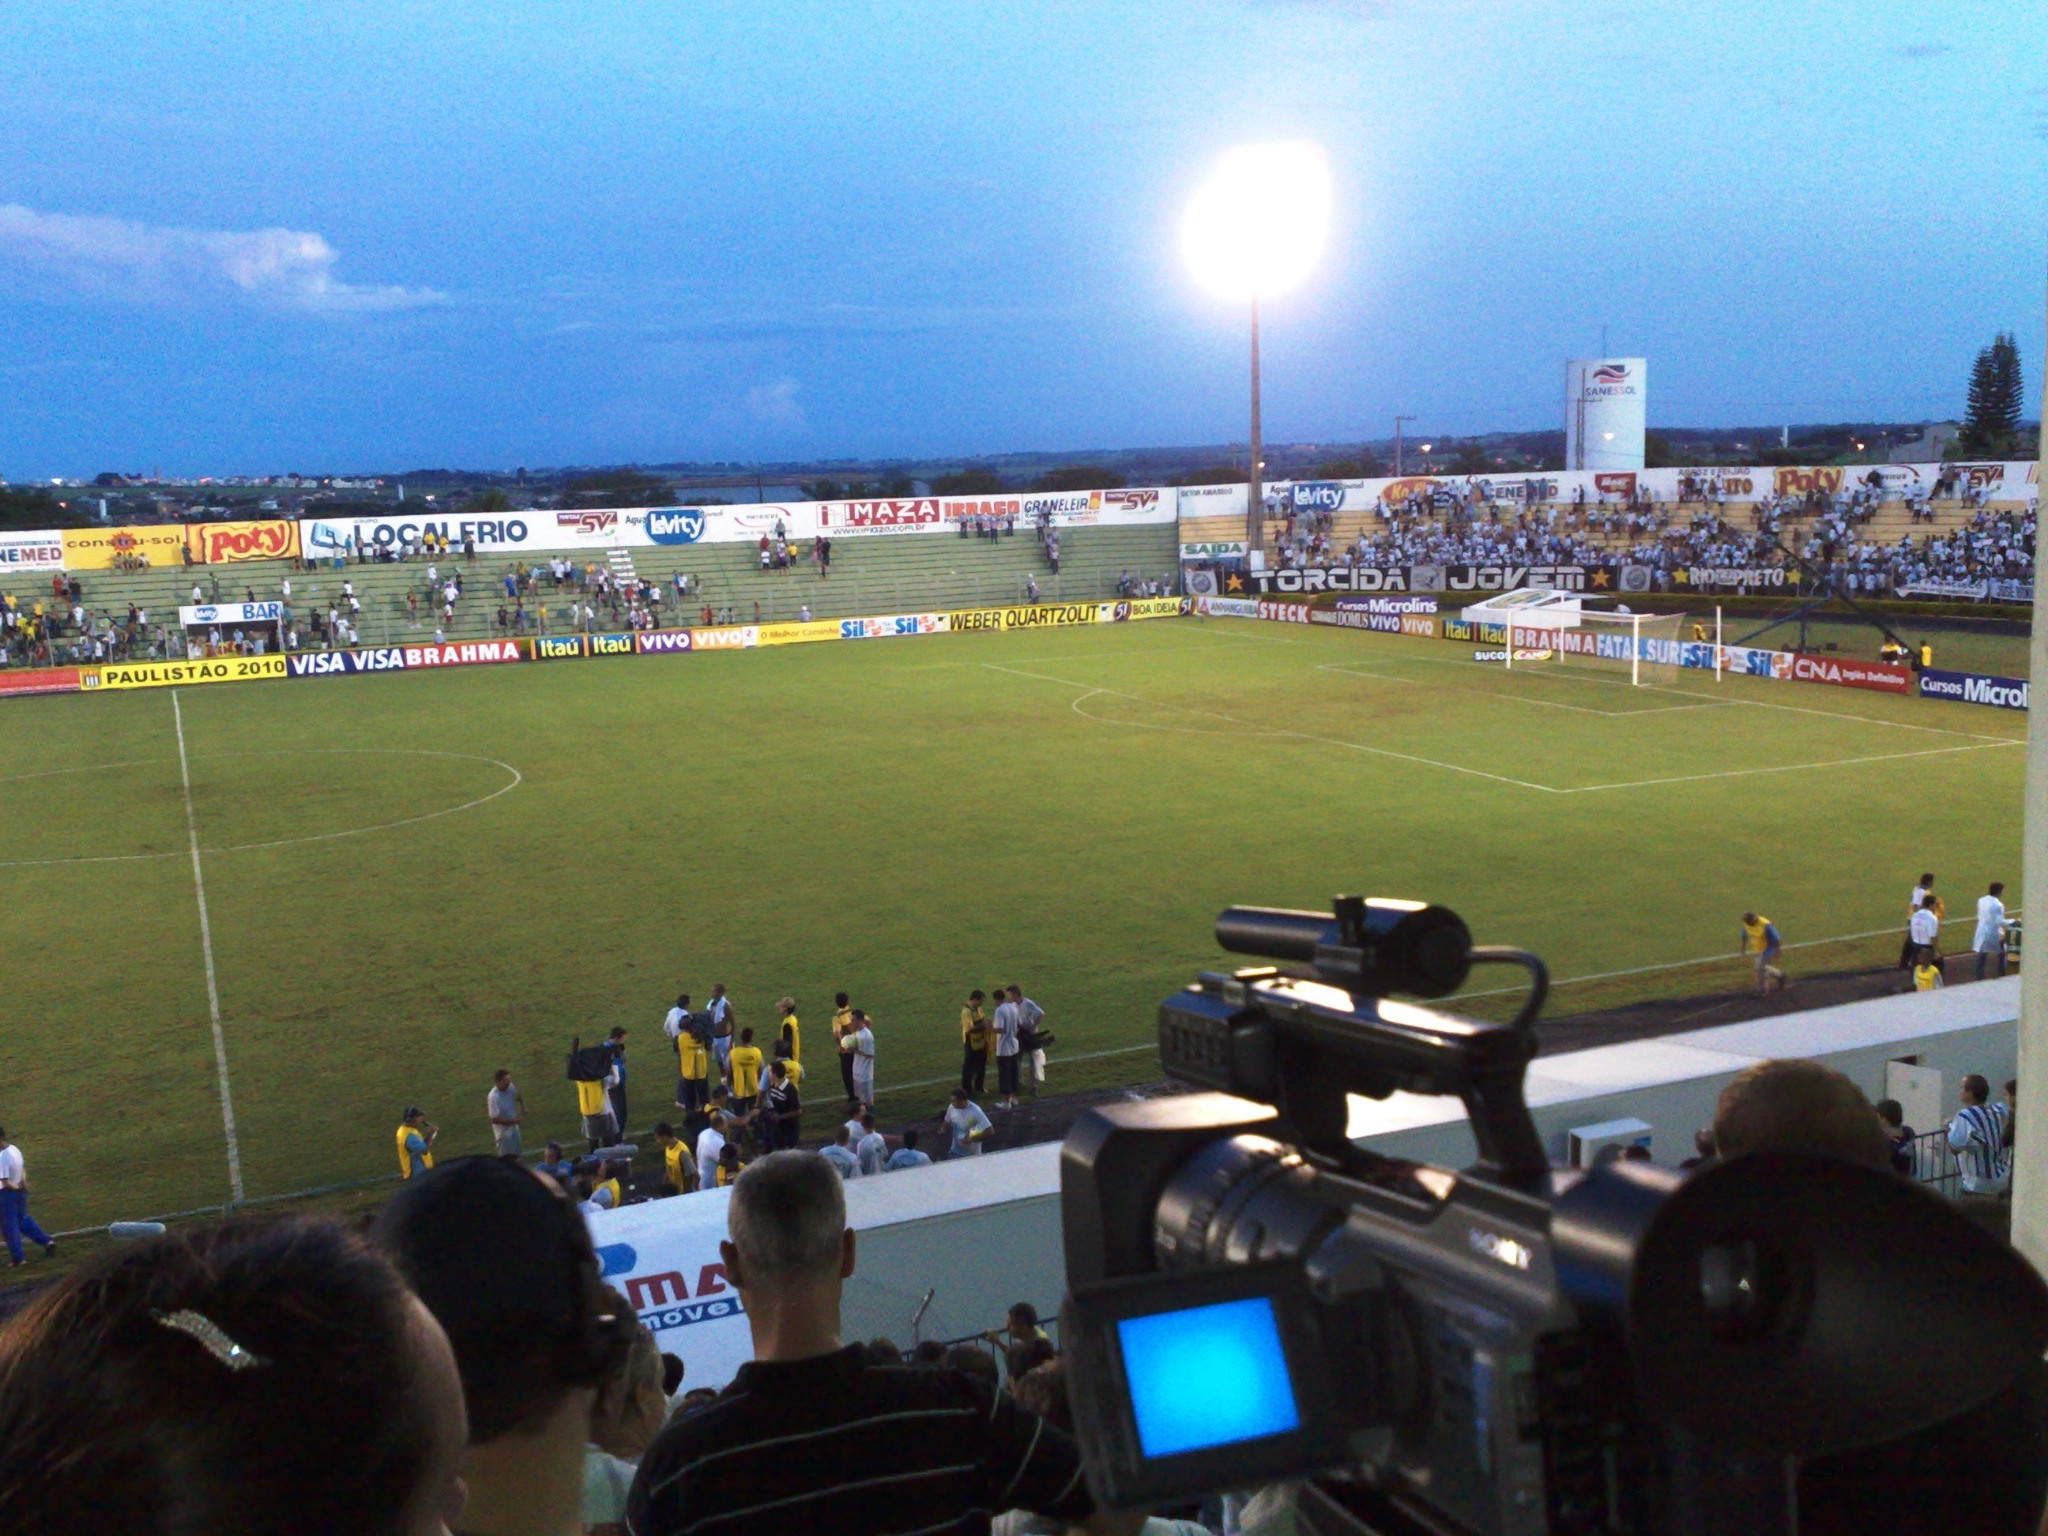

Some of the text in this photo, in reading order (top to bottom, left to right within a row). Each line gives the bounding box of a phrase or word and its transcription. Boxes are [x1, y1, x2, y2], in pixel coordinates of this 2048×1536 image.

[1585, 386, 1636, 396] SANESSOL
[845, 501, 936, 520] IMAZA
[353, 519, 528, 547] LOCALFRIO
[581, 513, 615, 533] SV
[211, 523, 286, 561] Poty
[1251, 566, 1585, 592] TORCIDA JOVEM
[243, 603, 279, 619] BAR
[1132, 601, 1178, 616] BOA IDEIA
[1259, 602, 1309, 624] STECK
[1336, 596, 1438, 613] Cursos Microlins
[895, 617, 918, 635] Sil
[950, 604, 1099, 632] WEBER QUARTZOLIT
[841, 620, 864, 639] Sil
[1445, 622, 1471, 640] Itaú
[1480, 624, 1507, 644] Itaú
[541, 639, 579, 657] Itaú
[593, 635, 631, 654] Itaú
[1514, 628, 1595, 654] BRAHMA
[293, 653, 346, 675] VISA
[352, 649, 404, 671] VISA
[406, 642, 519, 669] BRAHMA
[1747, 650, 1772, 676] Sil
[106, 660, 285, 684] PAULISTÃO 2010
[1795, 659, 1843, 682] CNA
[1921, 677, 1963, 694] Cursos
